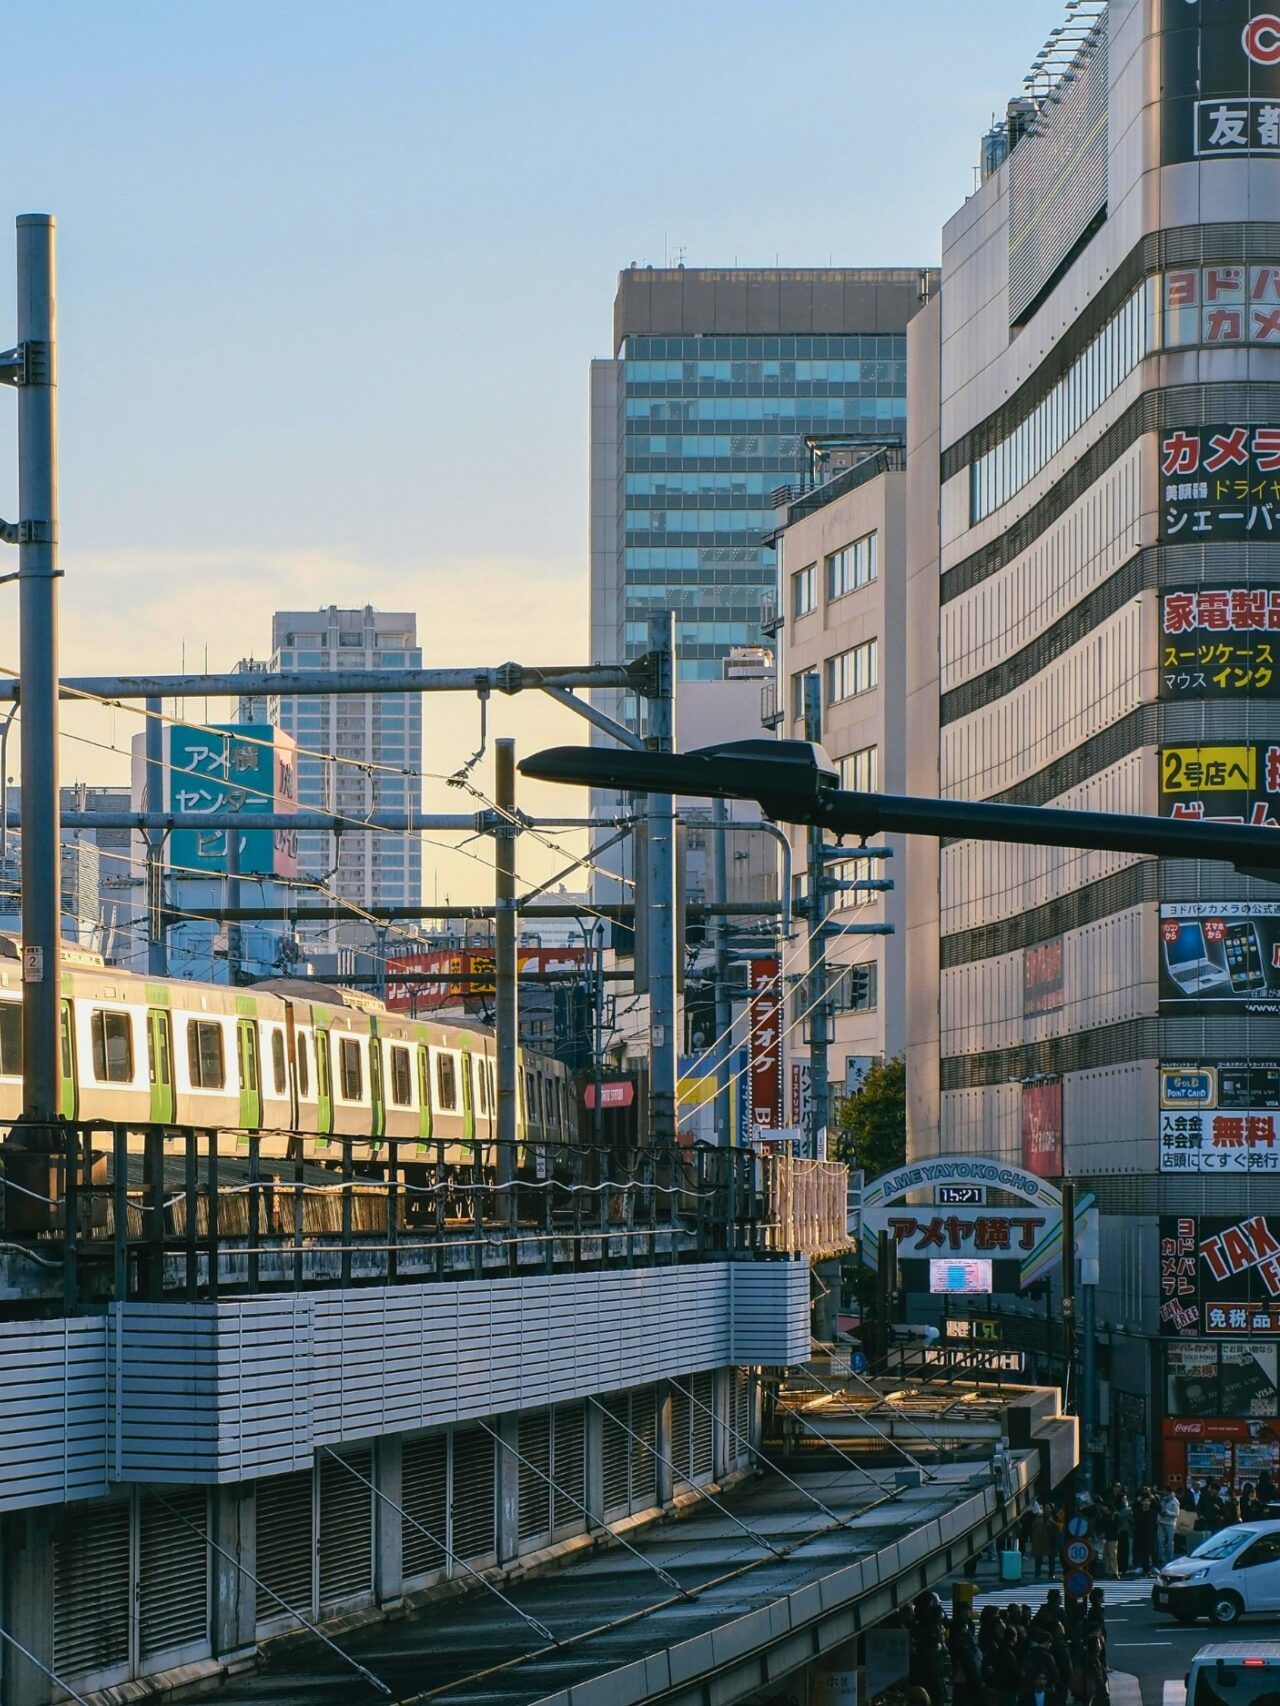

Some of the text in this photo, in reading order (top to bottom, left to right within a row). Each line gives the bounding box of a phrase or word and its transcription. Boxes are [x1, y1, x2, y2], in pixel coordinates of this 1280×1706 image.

[1166, 503, 1280, 534] シェーバ
[1164, 643, 1273, 666] スーツケース
[1164, 667, 1273, 689] マウス インク
[1165, 752, 1250, 790] 2号店へ
[175, 788, 268, 815] センター
[29, 956, 37, 967] 2
[1245, 1004, 1280, 1014] www.
[1163, 1115, 1276, 1148] 入会金 無料
[1163, 1133, 1203, 1149] 年会費
[1163, 1152, 1278, 1168] 店頭にてすぐ発行
[883, 1163, 1039, 1197] AMEYAYOKOCHO
[887, 1217, 1046, 1250] アメヤ横丁
[1177, 1218, 1196, 1295] ヨドバシ
[1200, 1216, 1280, 1282] TAX
[1162, 1237, 1177, 1296] カメラ
[1209, 1308, 1280, 1329] 免税品
[1254, 1386, 1275, 1399] VISA
[1070, 1545, 1087, 1560] 30
